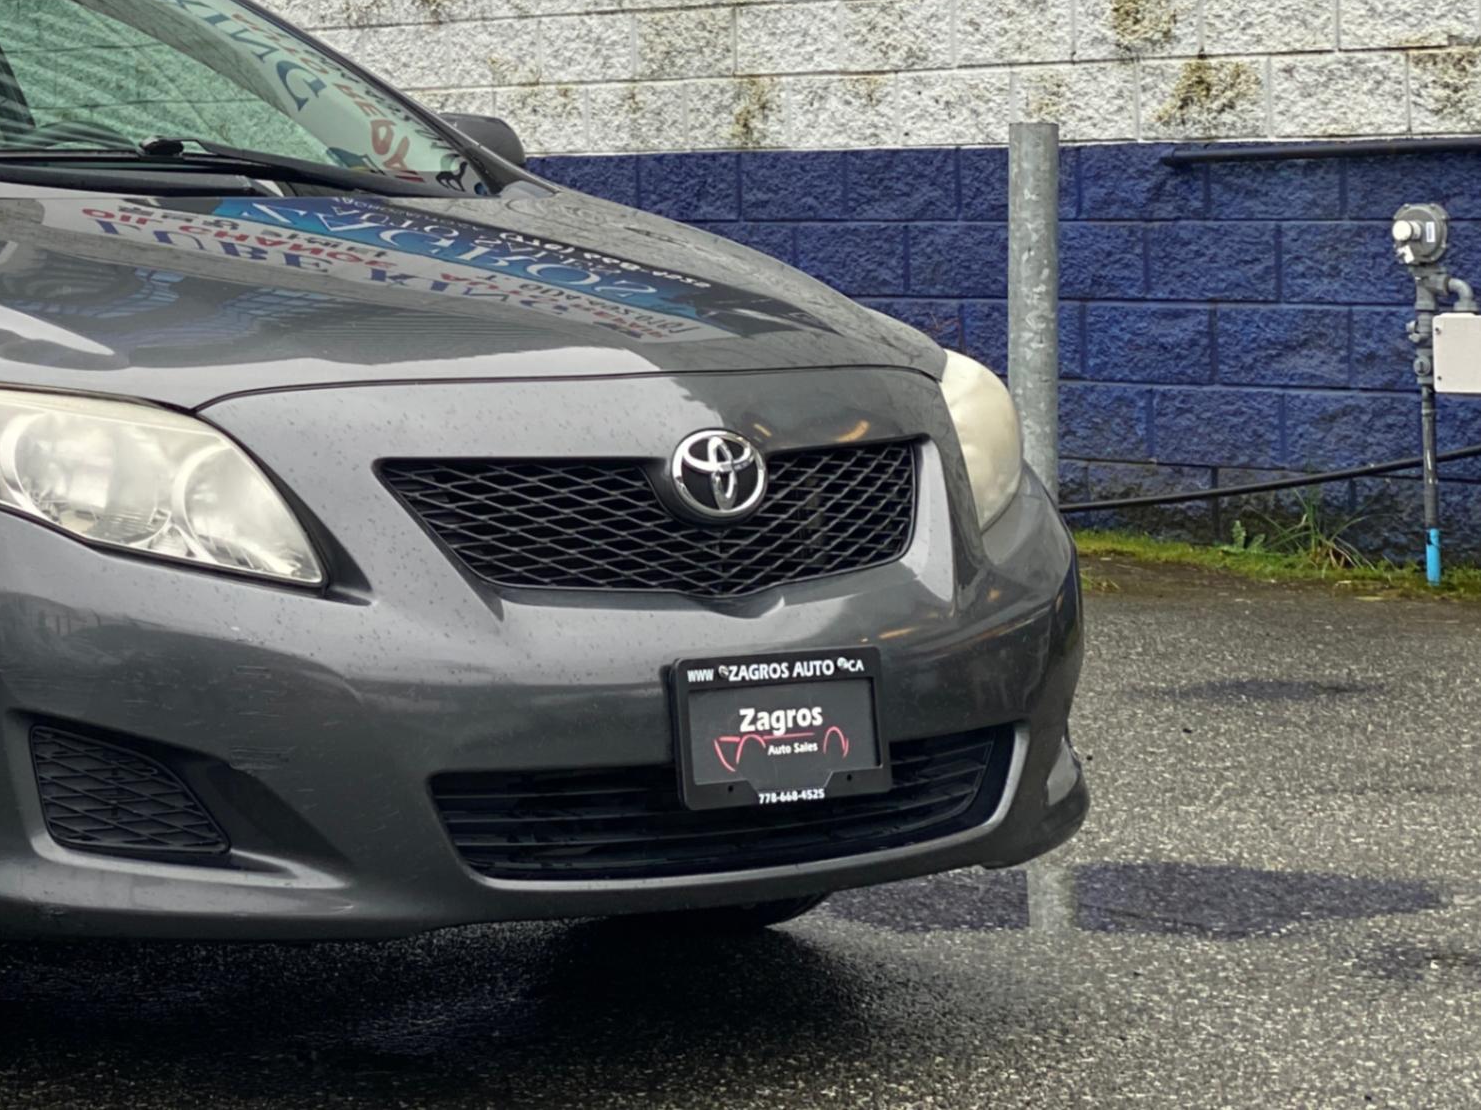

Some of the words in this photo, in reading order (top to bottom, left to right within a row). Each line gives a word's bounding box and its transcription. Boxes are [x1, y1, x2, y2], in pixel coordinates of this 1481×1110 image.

[687, 669, 714, 682] WWW
[728, 662, 789, 681] ZAGROS
[792, 659, 835, 677] AUTO
[739, 706, 824, 735] Zagros
[767, 744, 792, 756] Auto
[793, 741, 818, 754] Sales
[758, 788, 826, 805] 778-668-4525
